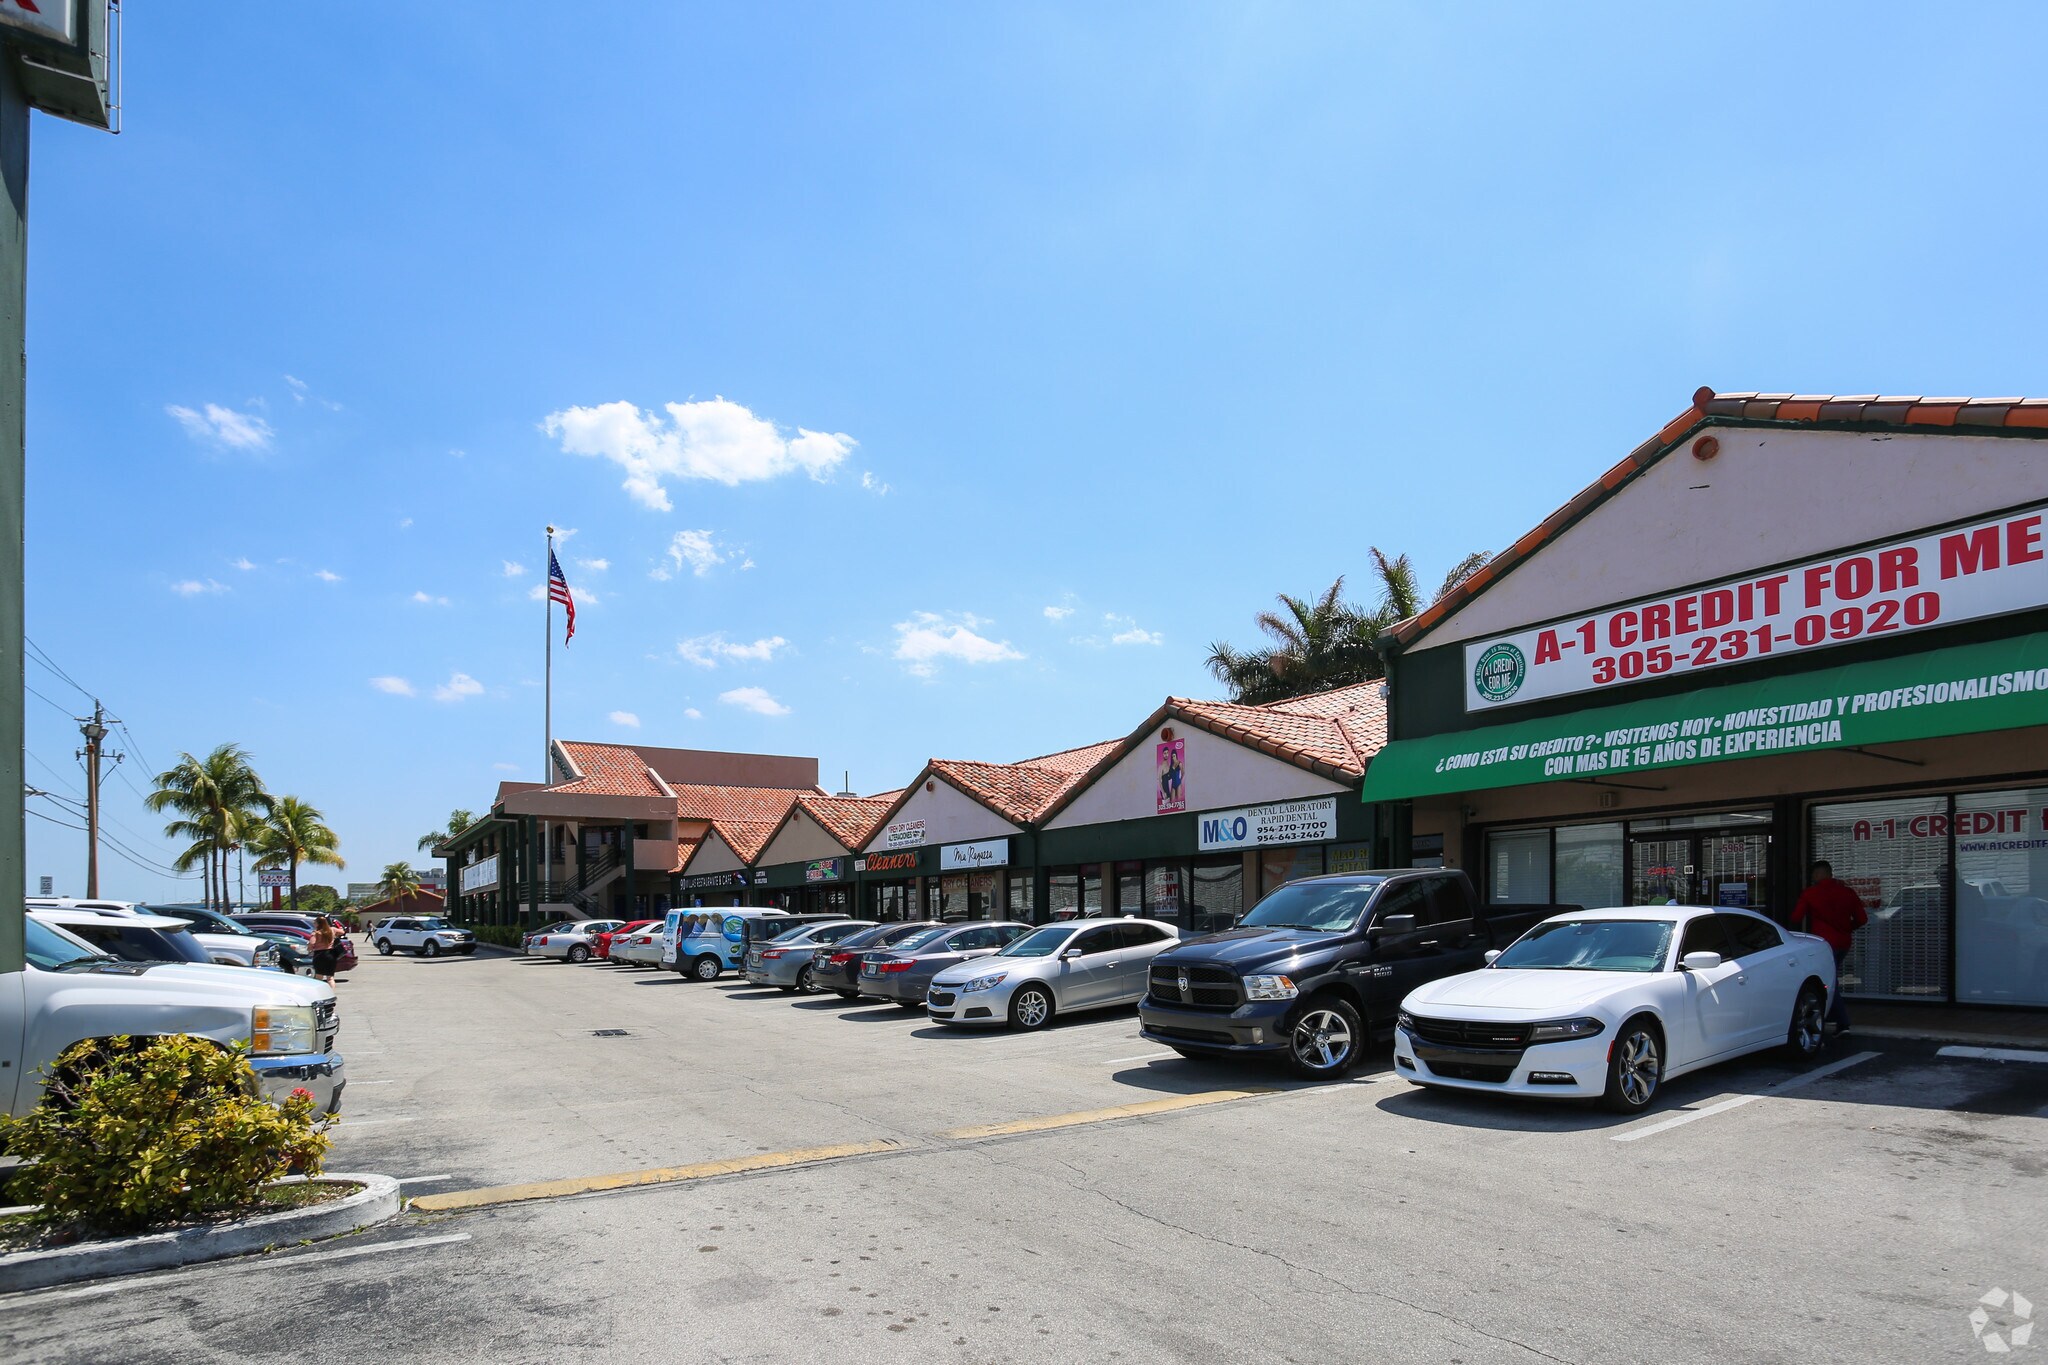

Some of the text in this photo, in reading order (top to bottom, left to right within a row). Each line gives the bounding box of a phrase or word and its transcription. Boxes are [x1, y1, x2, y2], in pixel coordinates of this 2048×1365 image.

[1534, 515, 2044, 666] A-1 CREDIT FOR ME
[1592, 592, 1940, 684] 305-231-0920
[1493, 658, 1514, 674] CREDIT
[1488, 672, 1511, 690] FOR ME
[1480, 746, 1508, 766] ESTA
[1510, 743, 1528, 761] SU
[1604, 722, 1678, 748] VISITENOS
[1722, 698, 1833, 732] HONESTIDAD
[1837, 696, 1850, 715] Y
[1851, 668, 2048, 714] PROFESIONALISMO
[1544, 720, 1842, 776] CON MAS DE 15 AÑOS DE EXPERIENCIA
[1247, 800, 1333, 818] DENTAL LABORATORY
[1261, 812, 1318, 824] RAPID DENTAL
[906, 820, 925, 830] CLEANERS
[1203, 816, 1248, 844] M&O
[1257, 821, 1328, 834] 954-270-7700
[1853, 818, 1896, 842] A-1
[1908, 809, 2029, 838] CREDIT
[1257, 830, 1326, 842] 954-643-2467
[1722, 844, 1745, 854] 5968
[866, 851, 916, 872] Cleaners
[943, 875, 993, 888] DRY CLEANERS
